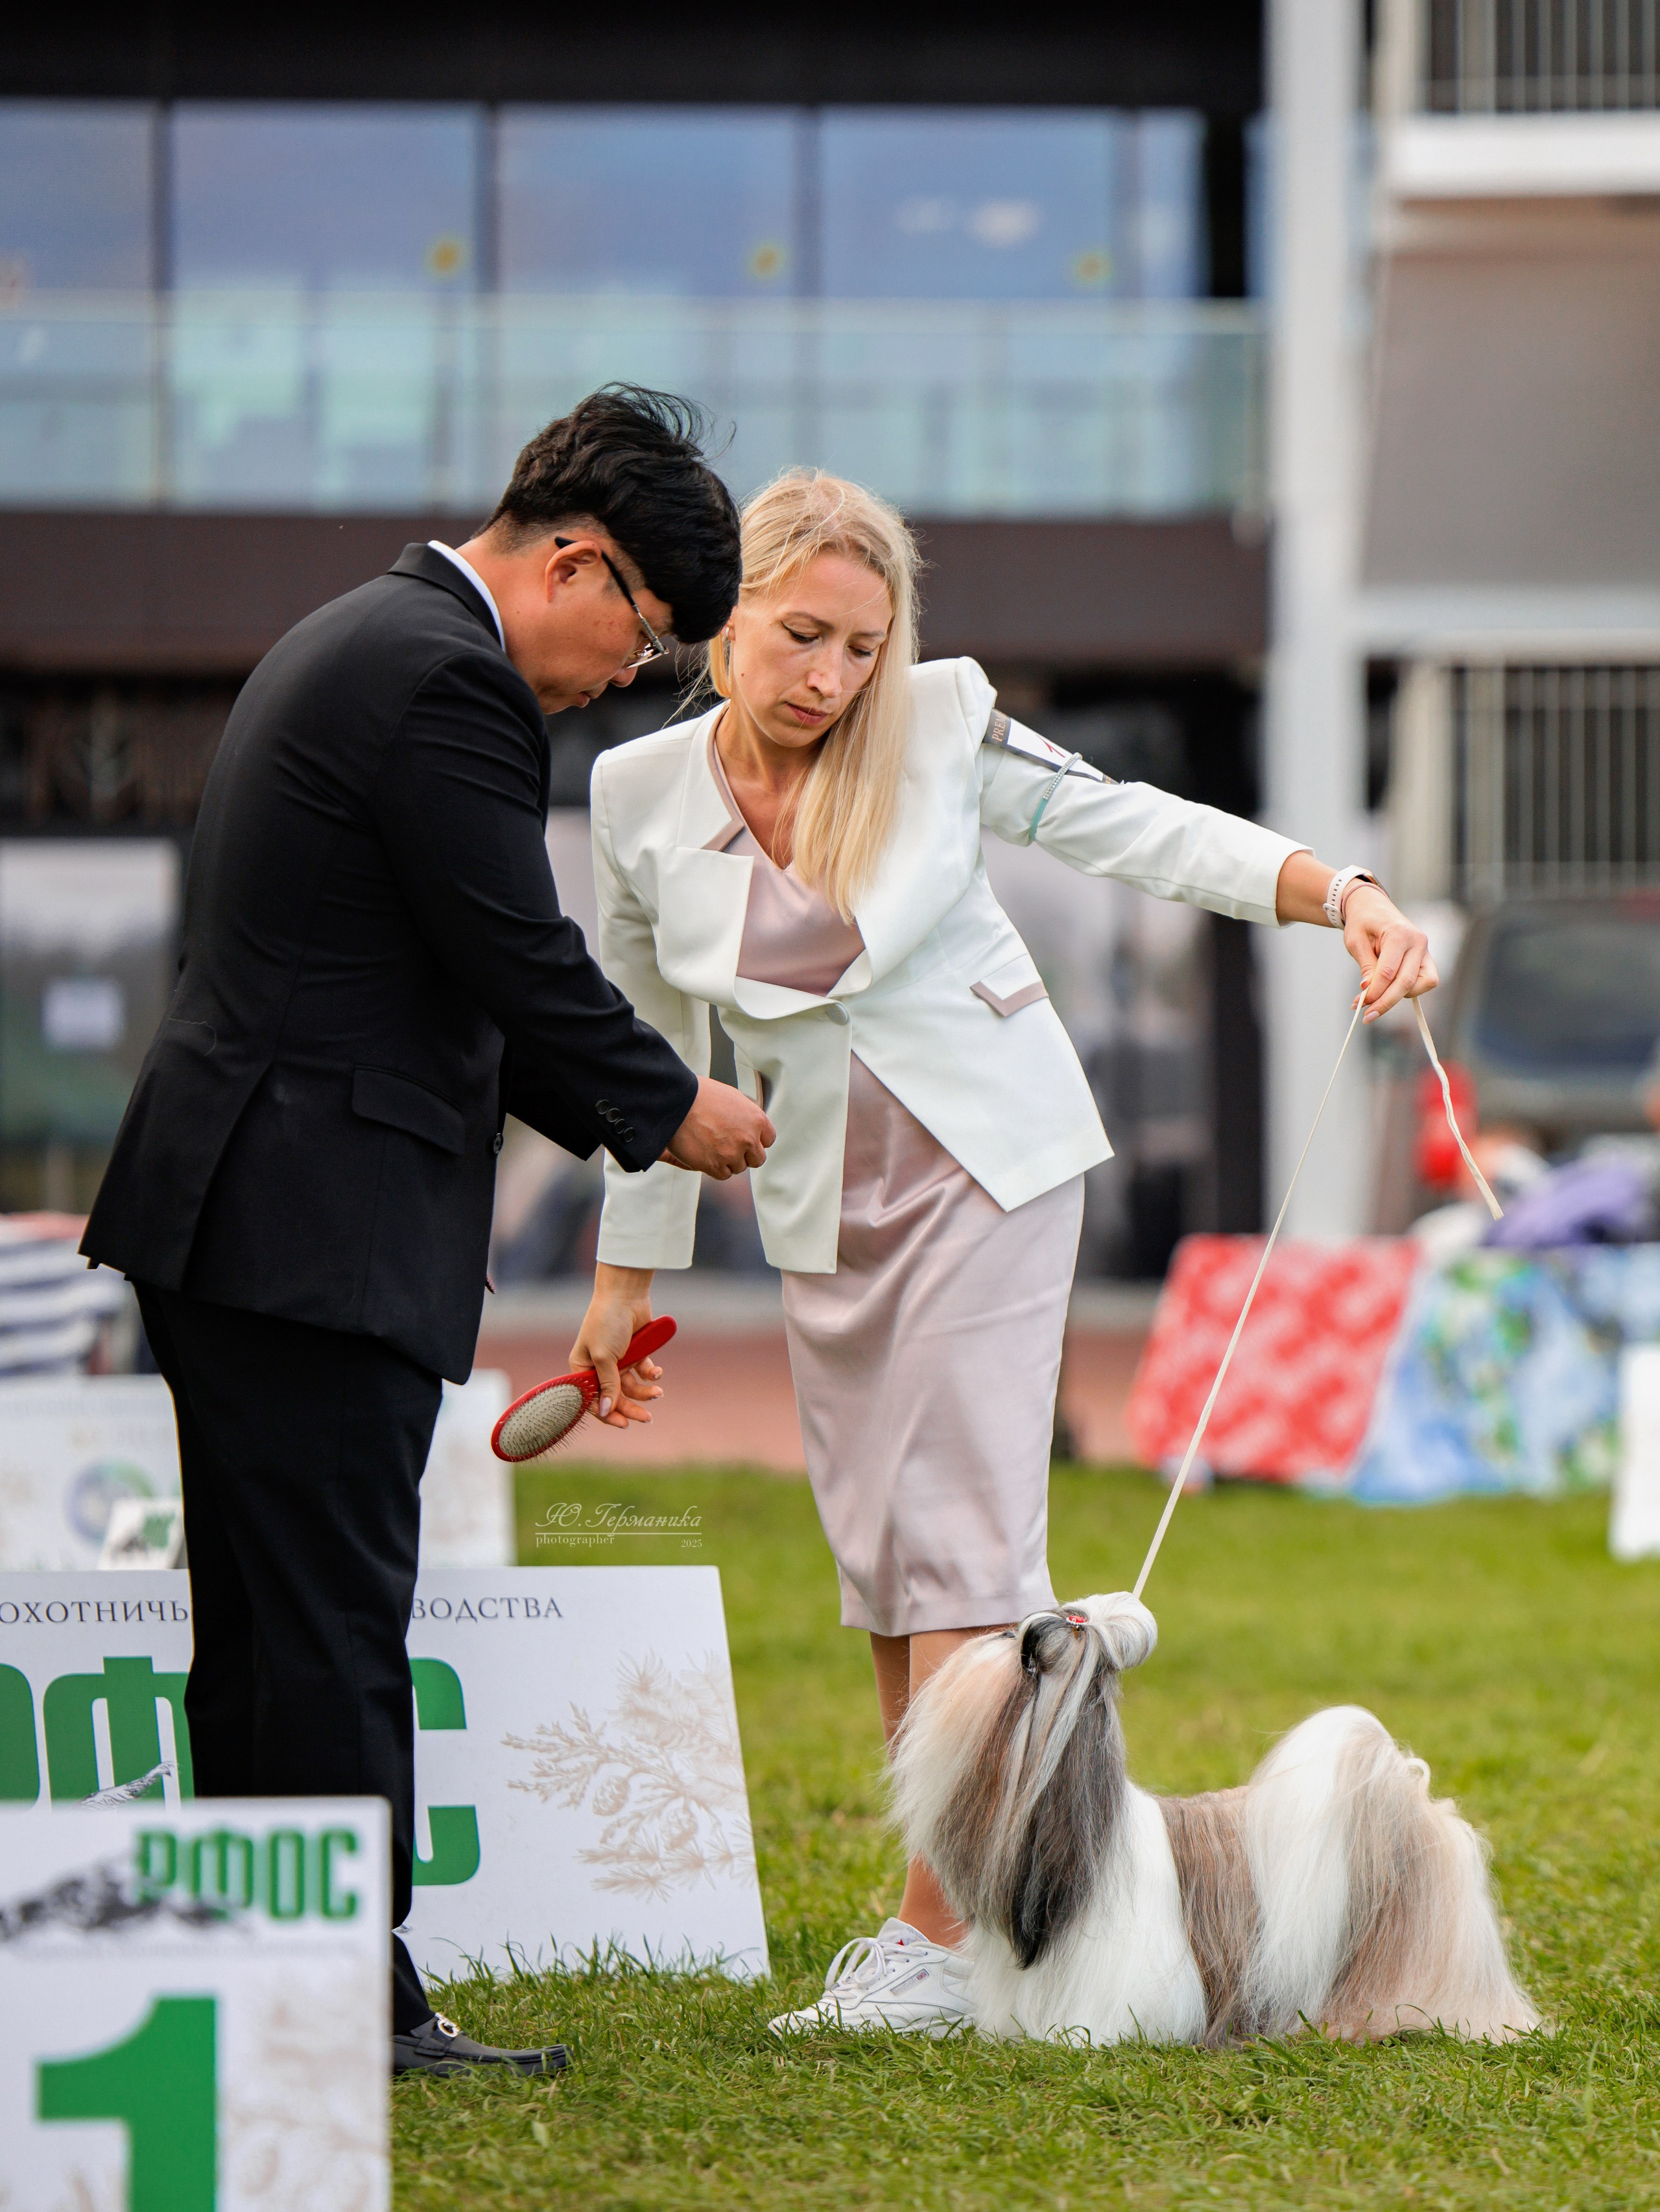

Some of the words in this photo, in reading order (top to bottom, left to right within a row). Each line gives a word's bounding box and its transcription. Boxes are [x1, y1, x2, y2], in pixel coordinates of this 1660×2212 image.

[0, 1600, 188, 1623] ОХОТНИЧЬ
[412, 1596, 563, 1623] ВОДСТВА
[35, 1993, 219, 2212] 1
